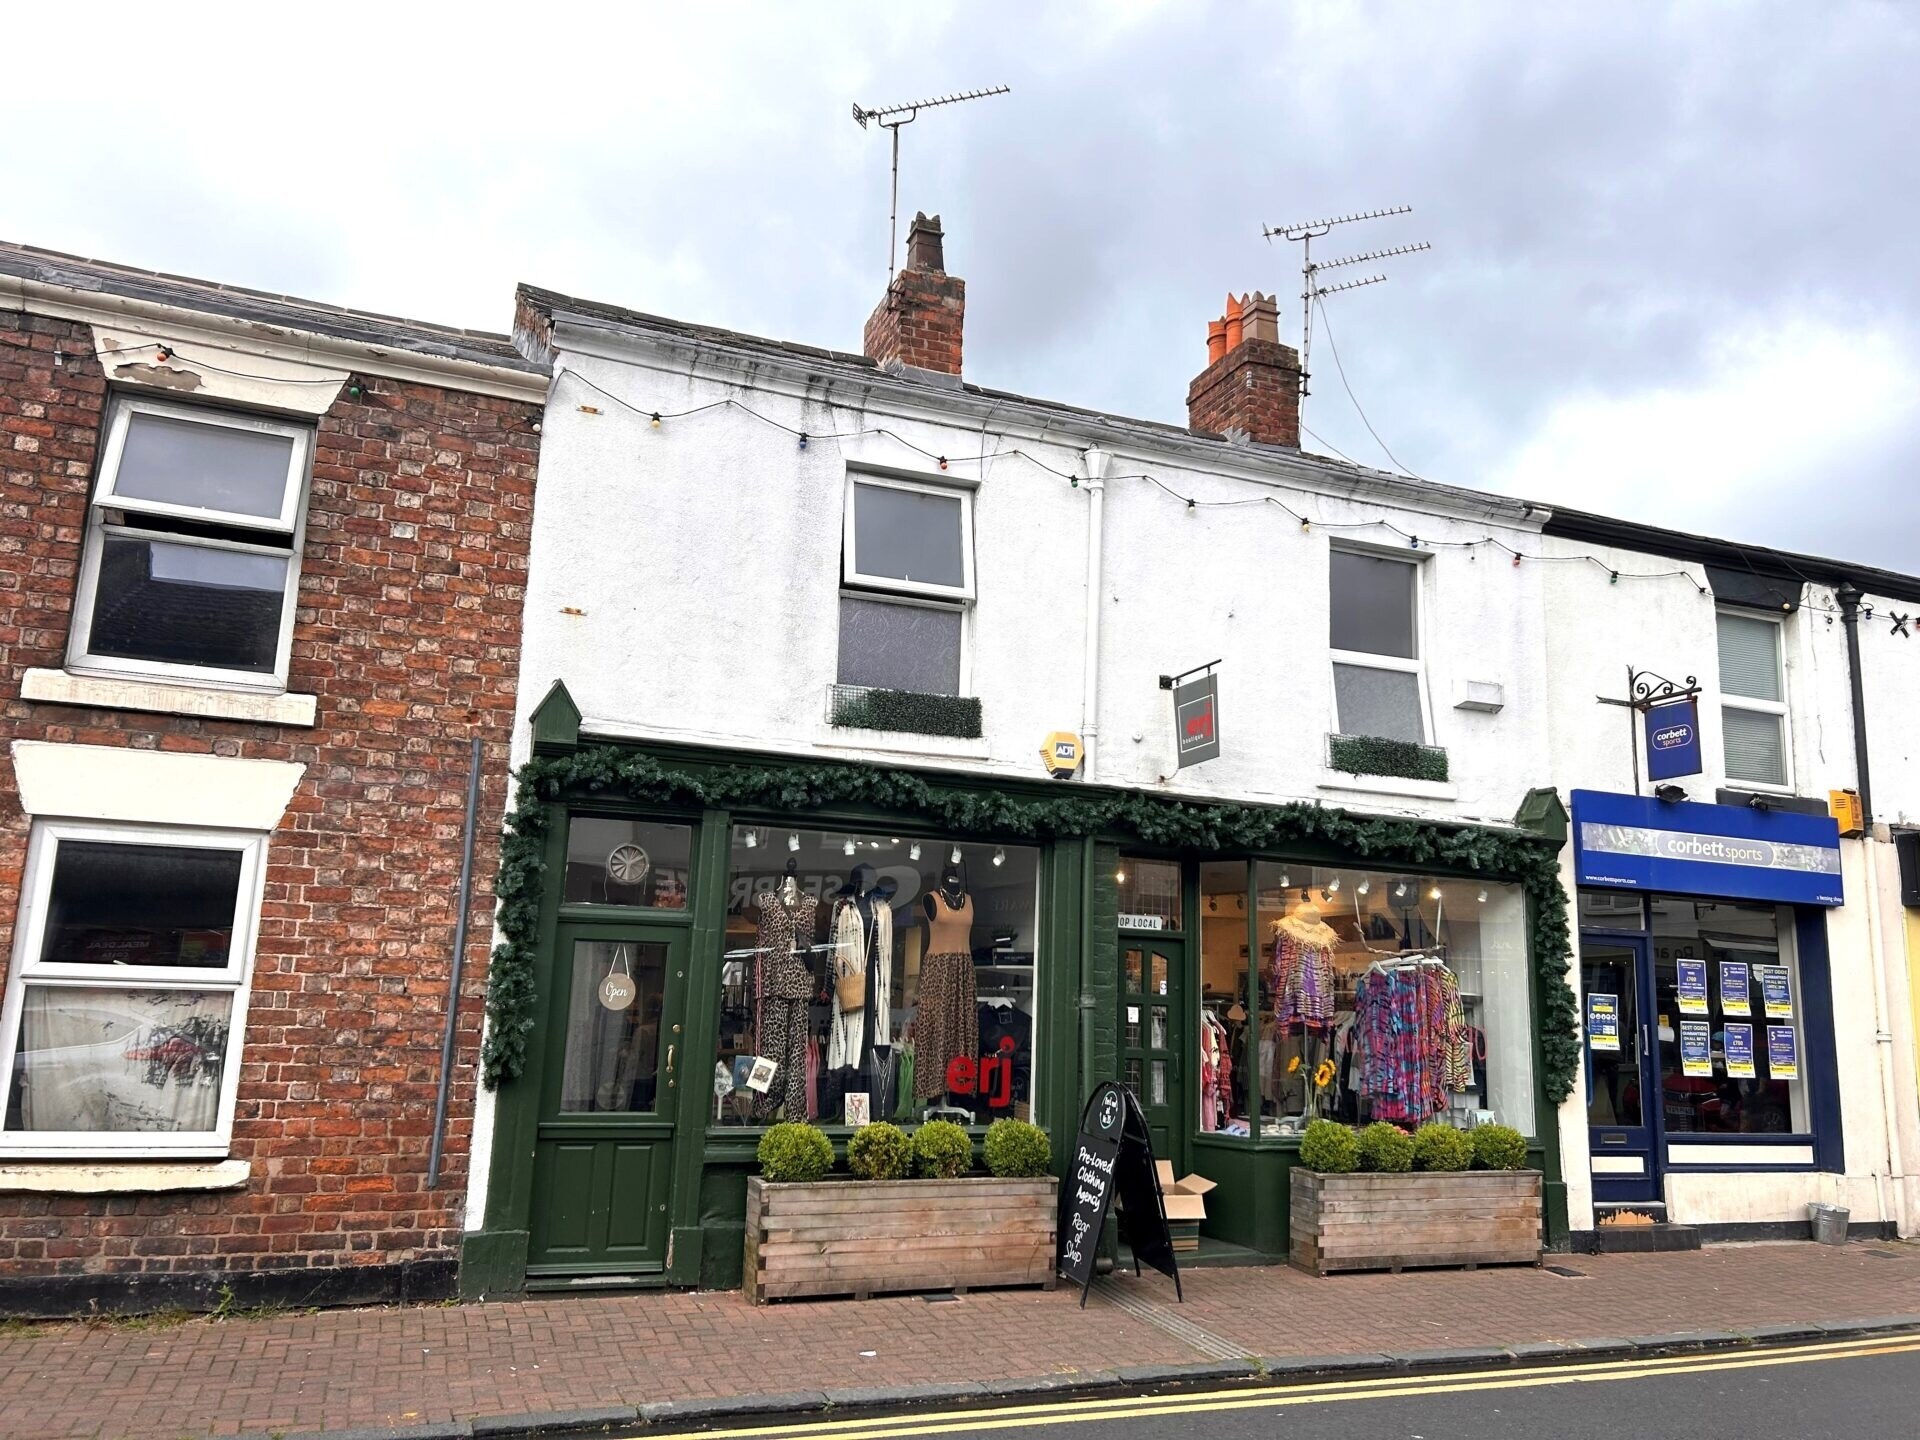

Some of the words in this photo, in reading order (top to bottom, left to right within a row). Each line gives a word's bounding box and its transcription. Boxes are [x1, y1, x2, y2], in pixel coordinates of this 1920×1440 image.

[1657, 728, 1687, 741] corbett
[1662, 738, 1681, 747] sports
[1056, 744, 1074, 757] ADT
[1668, 837, 1724, 857] corbett
[1725, 847, 1763, 864] sports
[1132, 918, 1158, 929] LOCAL
[605, 982, 628, 1002] Open
[946, 1034, 1016, 1107] erj
[1078, 1146, 1115, 1175] Pre-Loved
[1077, 1166, 1105, 1197] Clothing
[1076, 1185, 1101, 1212] Agency
[1072, 1212, 1090, 1233] Rear
[1063, 1239, 1082, 1268] Shop
